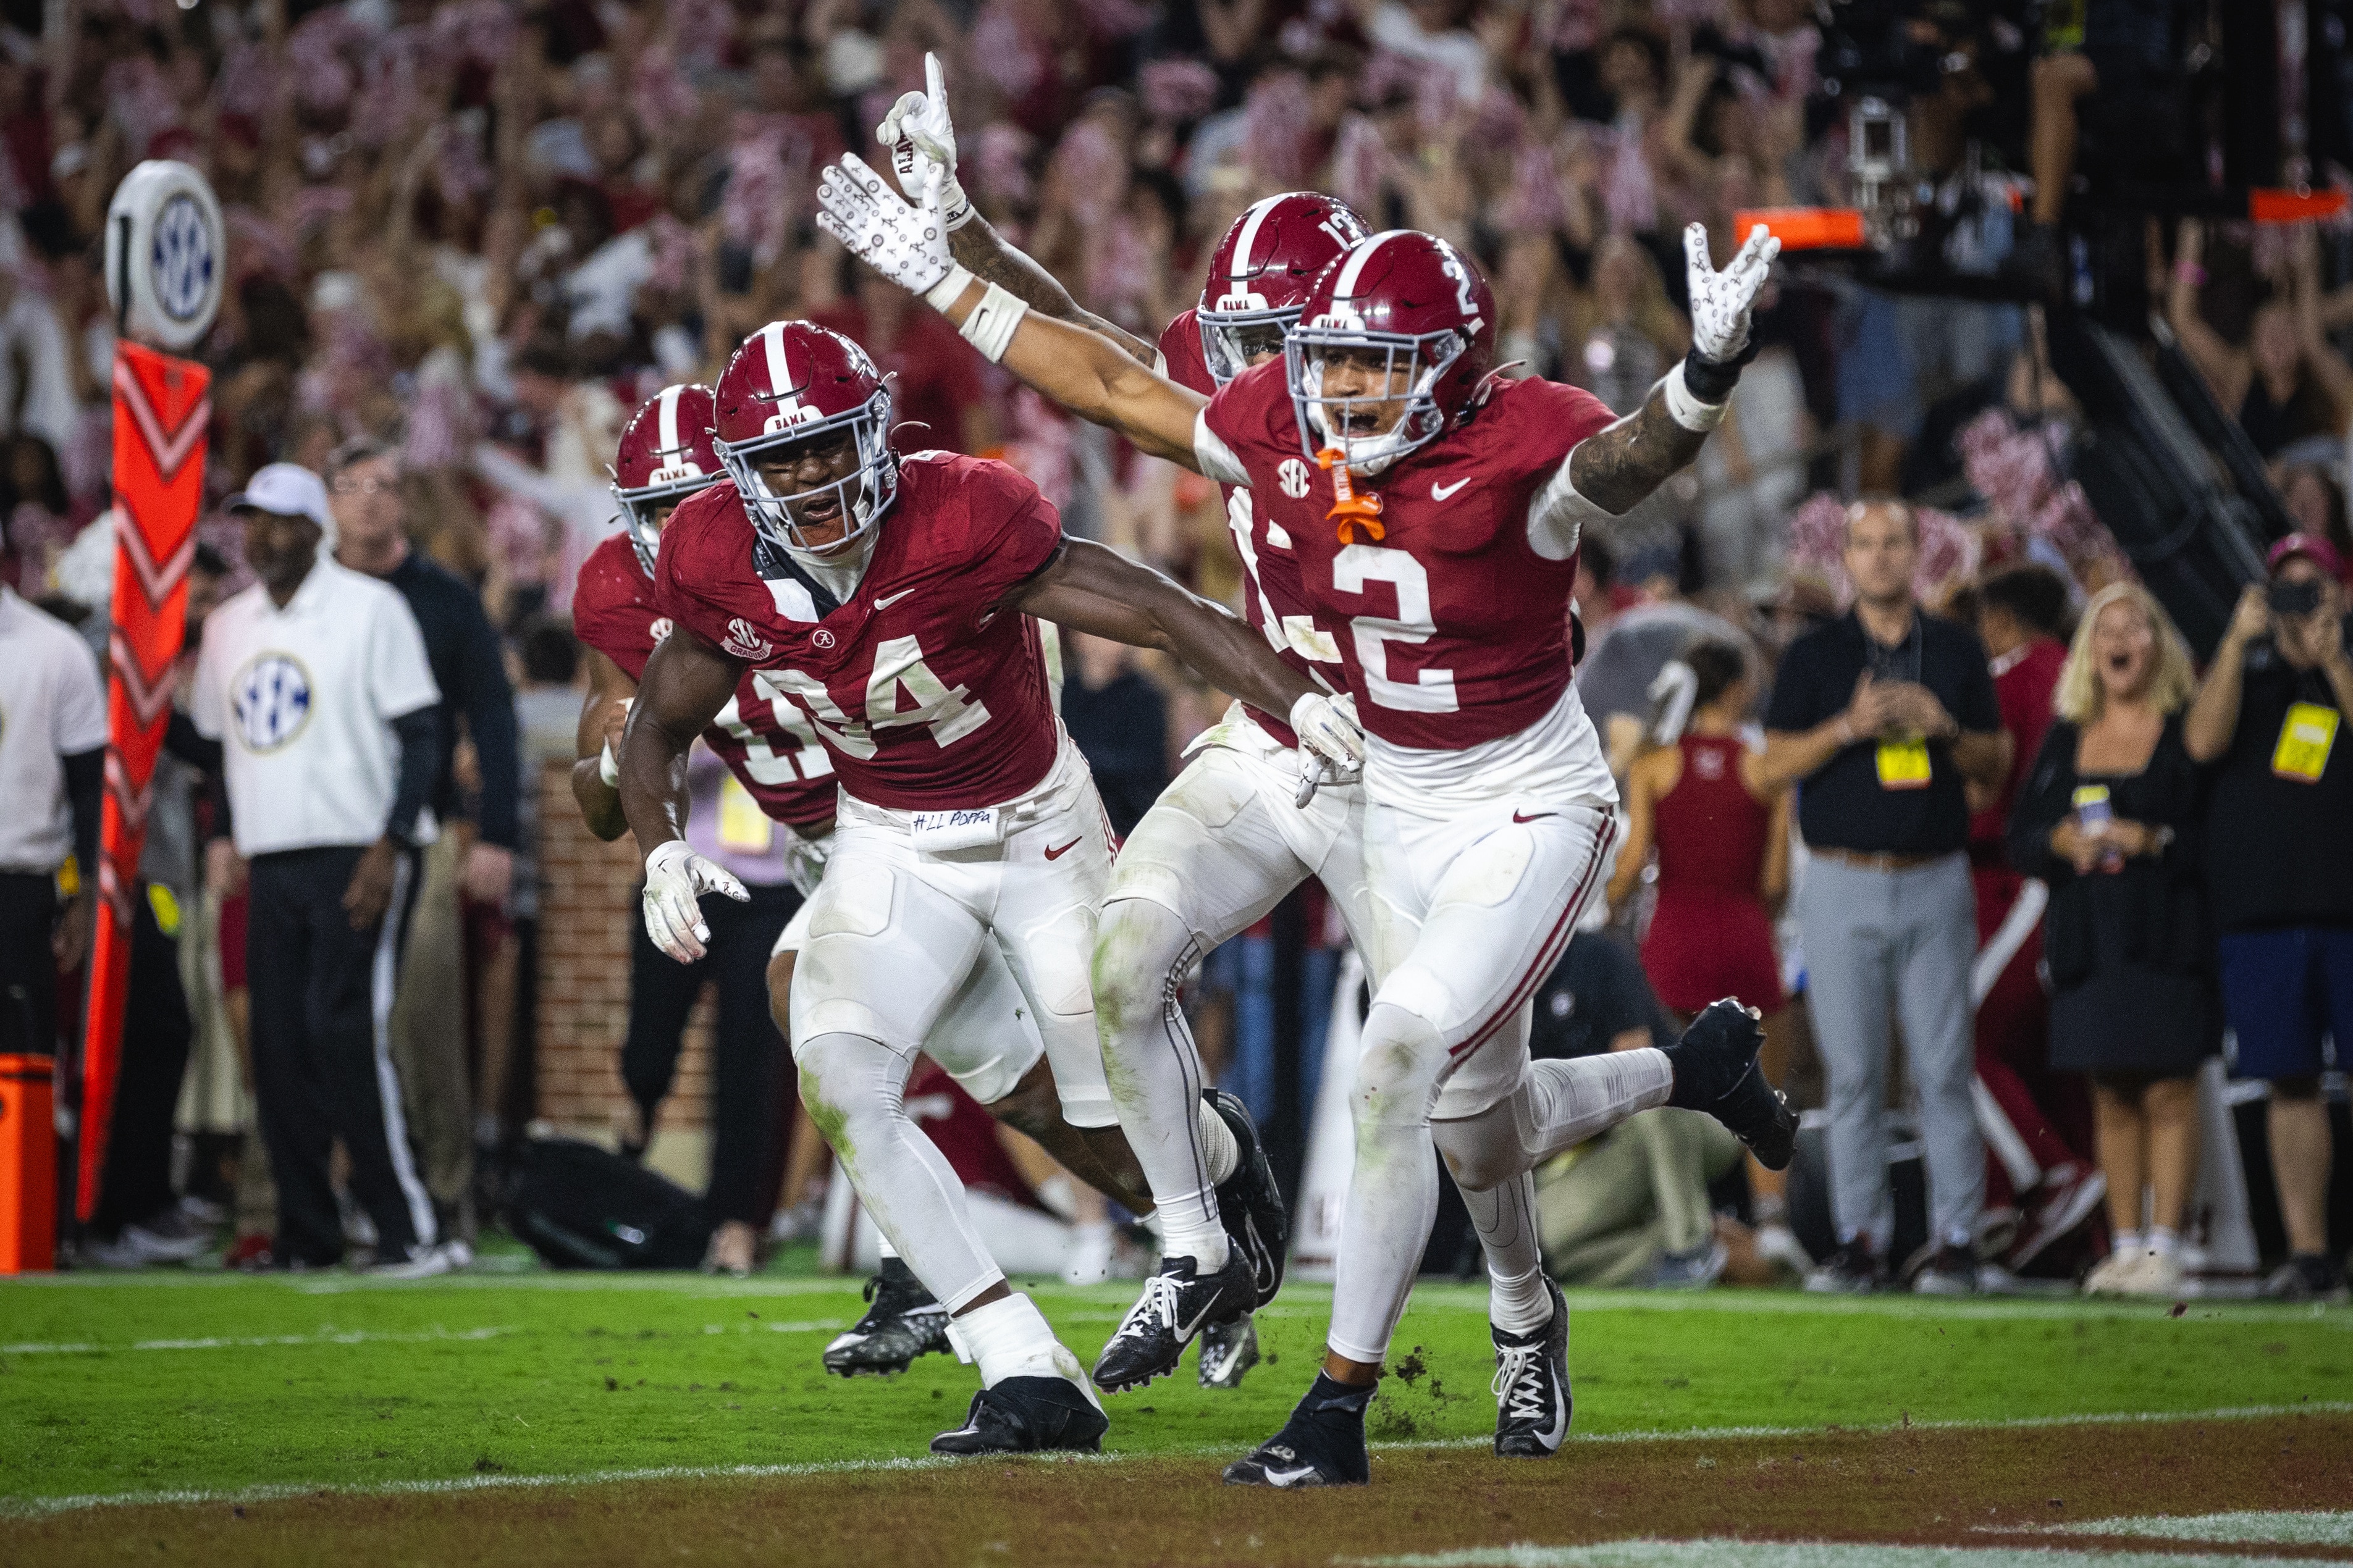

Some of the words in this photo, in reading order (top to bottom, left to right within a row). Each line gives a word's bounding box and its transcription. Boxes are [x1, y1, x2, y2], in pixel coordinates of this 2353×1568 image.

[1442, 254, 1480, 315] 2
[775, 412, 807, 430] BAMA
[1277, 458, 1310, 498] SEC
[728, 618, 760, 648] SEC
[1332, 543, 1460, 713] 2
[730, 644, 768, 660] GRADUATE
